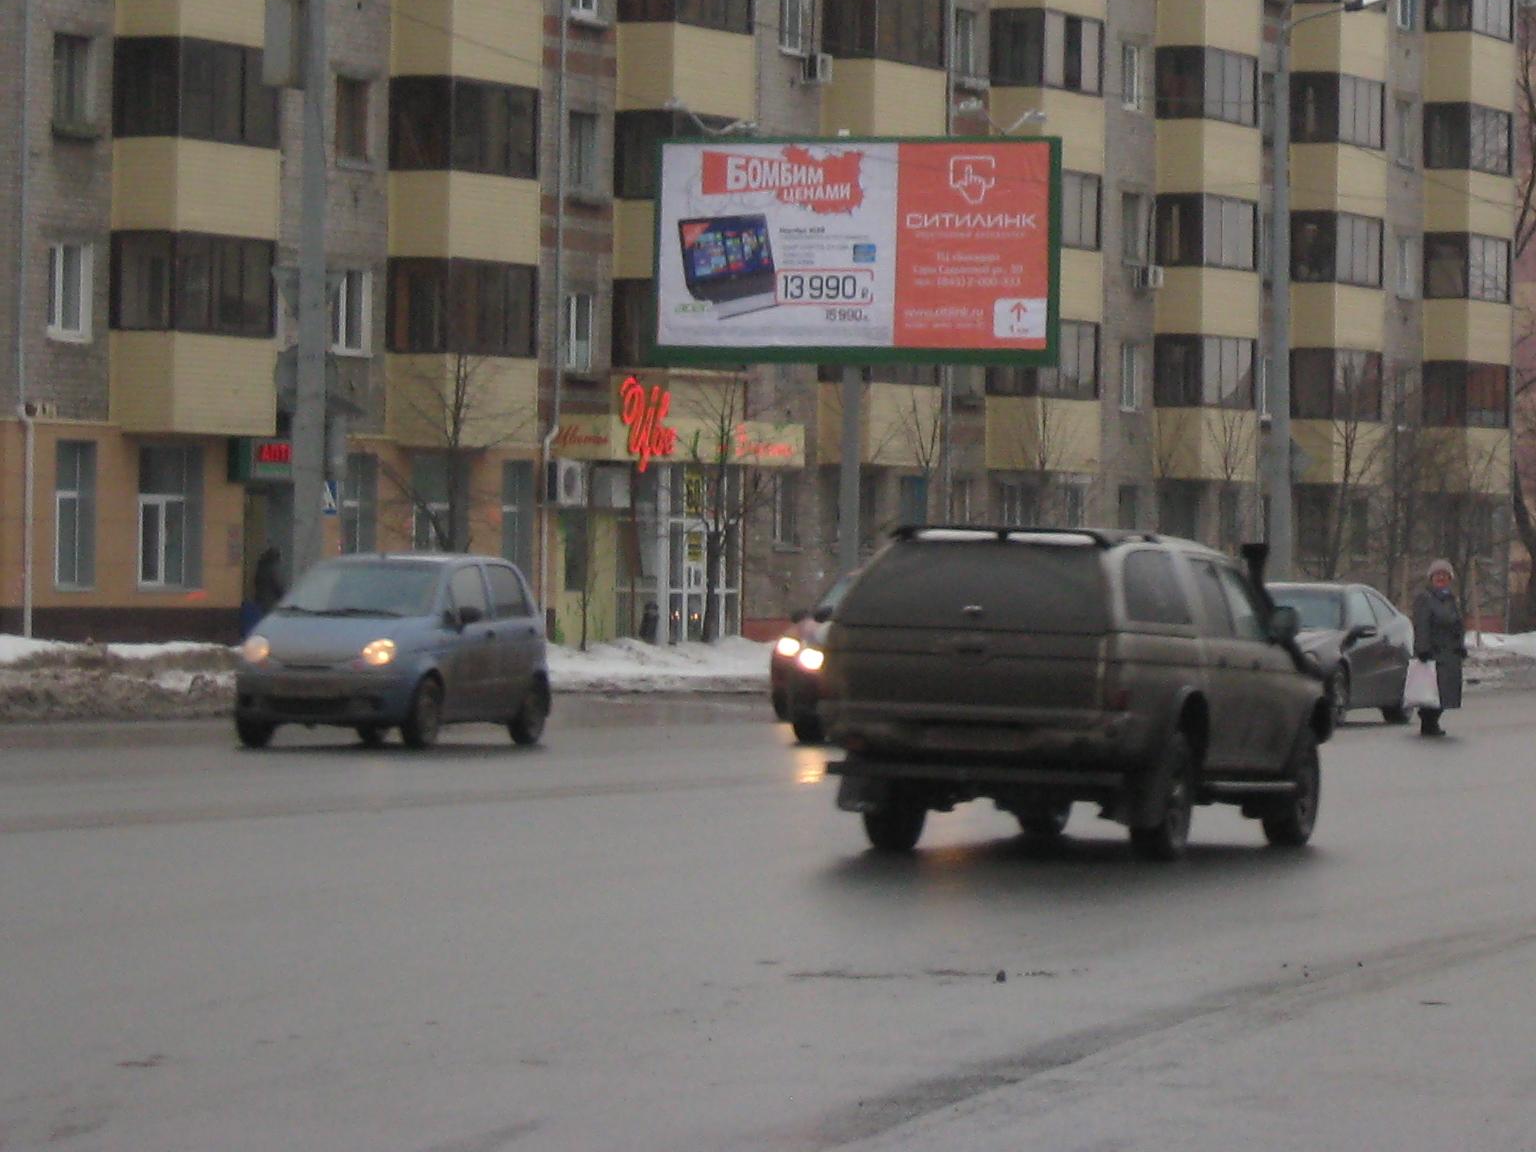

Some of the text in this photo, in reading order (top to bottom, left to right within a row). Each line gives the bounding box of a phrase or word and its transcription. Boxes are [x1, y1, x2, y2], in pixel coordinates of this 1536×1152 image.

[727, 156, 823, 191] БОМБИМ
[783, 183, 851, 203] ЦЕНАМИ
[906, 212, 1038, 229] СИТИЛИНК
